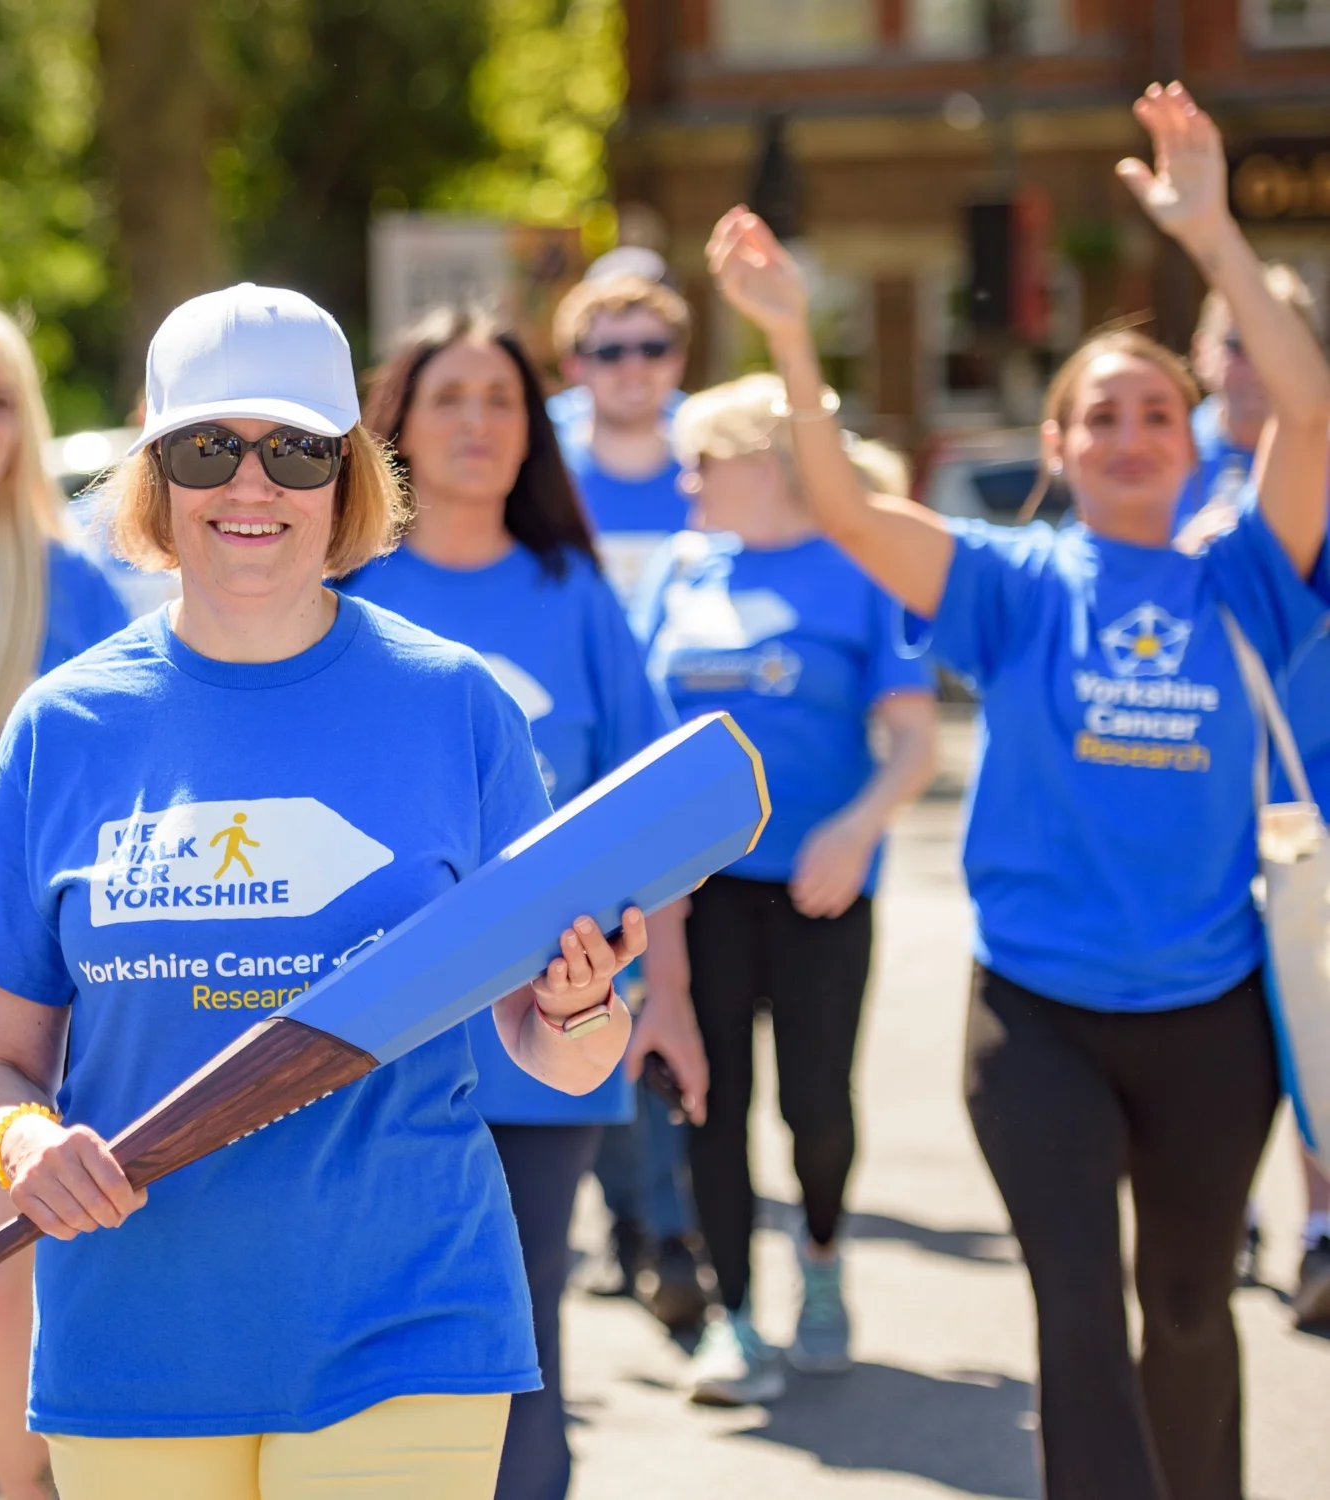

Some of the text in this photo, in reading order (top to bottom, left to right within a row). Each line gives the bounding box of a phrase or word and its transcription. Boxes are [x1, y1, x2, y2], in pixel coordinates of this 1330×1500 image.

[115, 823, 157, 847] WE
[107, 863, 170, 887] FOR
[105, 880, 289, 911] YORKSHIRE
[78, 952, 324, 984] Yorkshire Cancer
